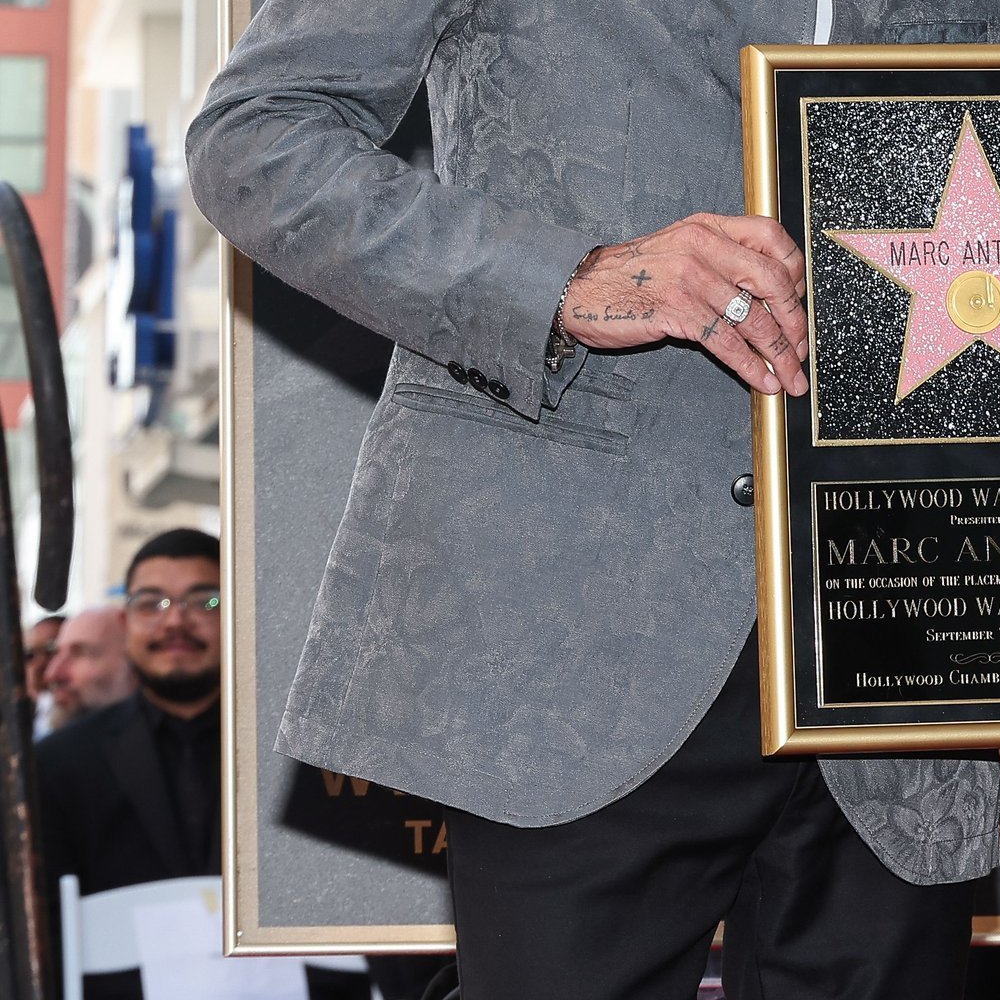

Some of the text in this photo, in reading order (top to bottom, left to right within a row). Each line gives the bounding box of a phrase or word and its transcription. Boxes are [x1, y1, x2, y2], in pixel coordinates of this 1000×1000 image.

[890, 241, 949, 266] MARC
[825, 489, 962, 510] HOLLYWOOD
[827, 536, 938, 566] MARC
[826, 579, 839, 589] ON
[845, 578, 865, 588] THE
[869, 577, 917, 588] OCCASION
[923, 576, 935, 587] OF
[940, 576, 960, 586] THE
[829, 598, 966, 620] HOLLYWOOD
